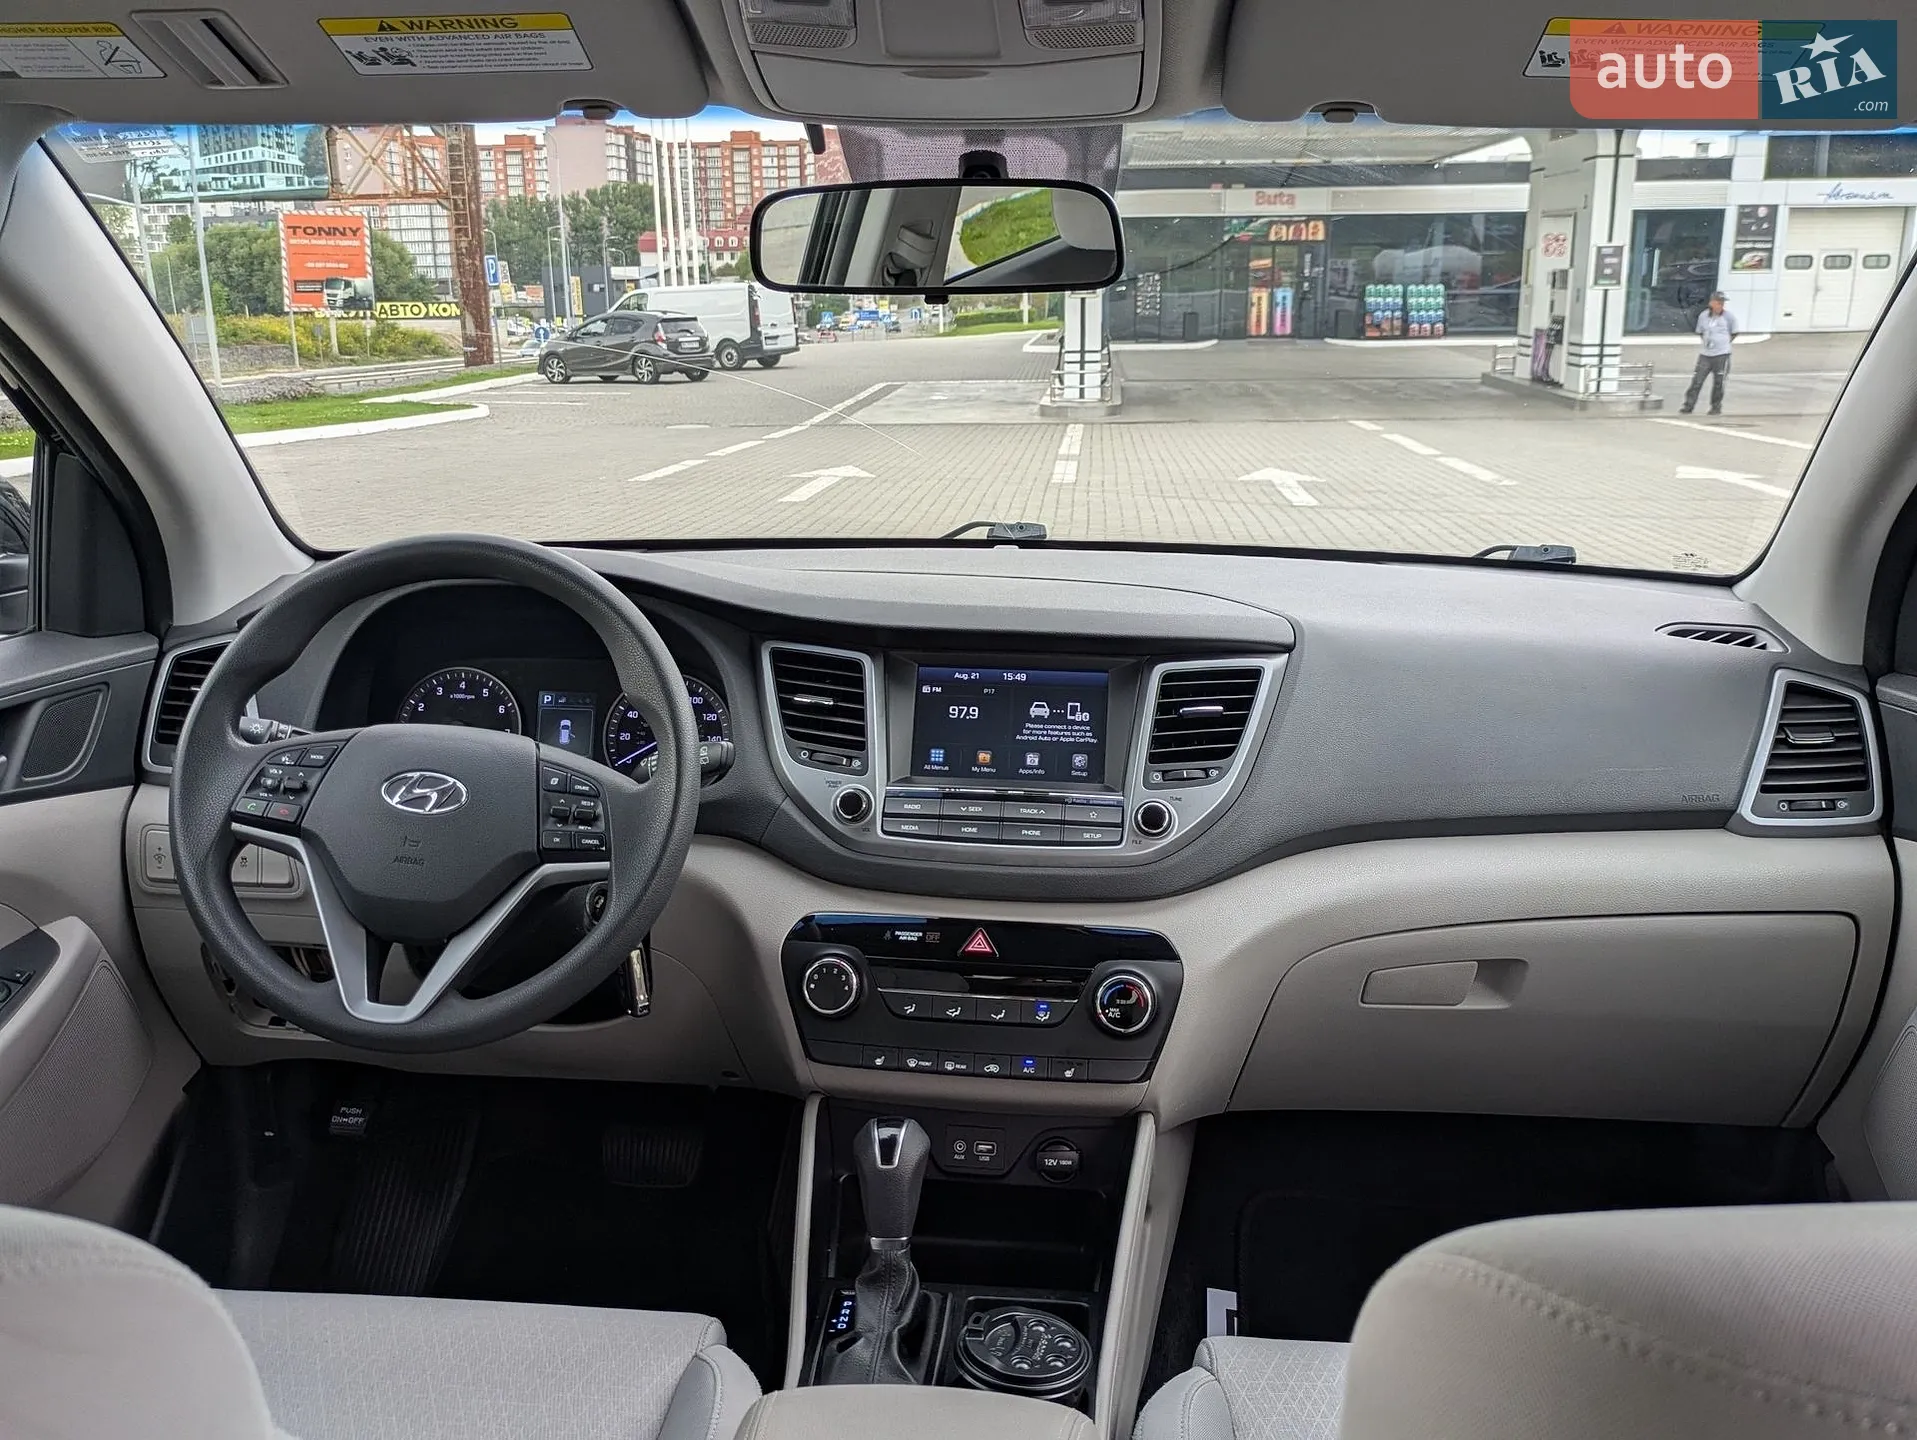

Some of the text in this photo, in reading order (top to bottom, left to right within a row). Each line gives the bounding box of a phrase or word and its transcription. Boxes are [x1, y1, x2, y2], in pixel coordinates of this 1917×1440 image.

[400, 17, 518, 32] WARNING
[287, 226, 361, 236] TONNY
[378, 304, 423, 317] АВТО
[954, 672, 969, 680] Aug.
[1003, 673, 1027, 681] 15:49
[460, 681, 466, 689] 4
[436, 687, 443, 695] 3
[482, 688, 489, 697] 5
[544, 695, 552, 704] P
[418, 703, 425, 711] 2
[498, 705, 505, 714] 6
[627, 711, 638, 719] 40
[703, 713, 717, 721] 120
[949, 706, 979, 719] 97.9
[619, 732, 630, 741] 20
[1681, 794, 1720, 803] AIRBAG
[392, 855, 425, 865] AIRBAG
[340, 1106, 362, 1114] PUSH
[1044, 1158, 1058, 1166] 12V
